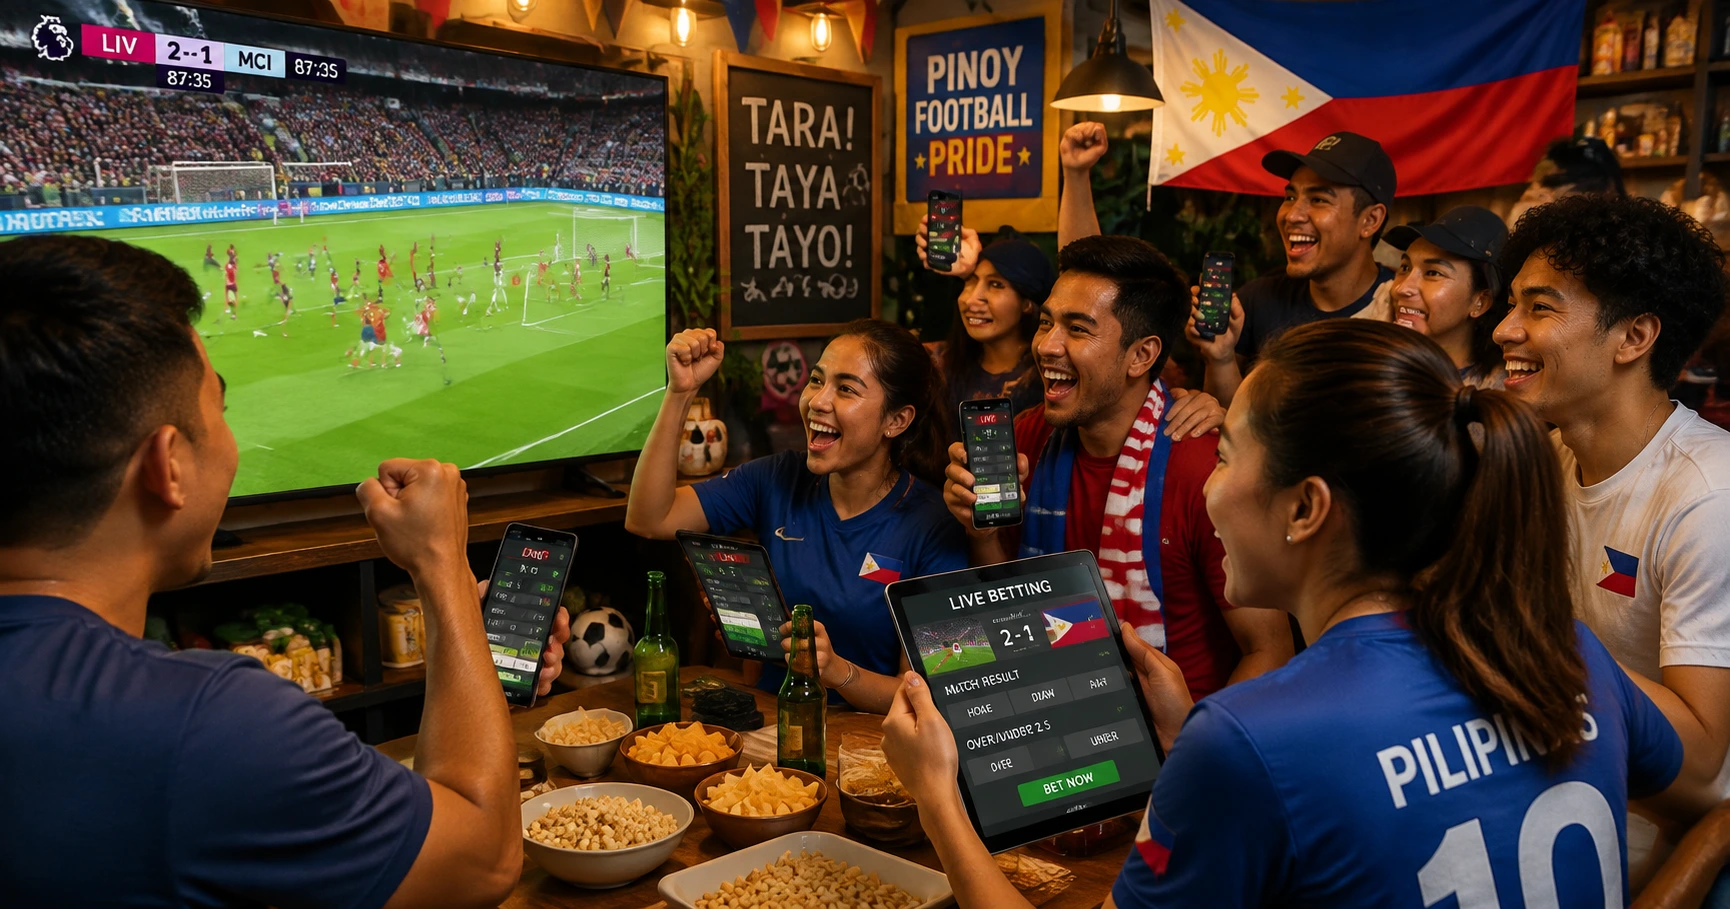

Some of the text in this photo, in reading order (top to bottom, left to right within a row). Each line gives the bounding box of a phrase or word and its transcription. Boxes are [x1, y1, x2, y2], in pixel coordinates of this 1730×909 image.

[102, 33, 137, 55] LIV
[238, 50, 272, 71] MCI
[294, 58, 338, 79] 87:35
[927, 45, 1024, 94] PINOY
[166, 70, 212, 89] 87:35
[741, 96, 855, 151] TARA!
[915, 92, 1033, 134] FOOTBALL
[929, 134, 1014, 177] PRIDE
[745, 162, 842, 210] TAYA
[744, 224, 853, 269] TAYO!
[949, 580, 1052, 610] LIVE BETTING
[981, 670, 1020, 687] RESULT
[1043, 772, 1094, 795] BET NOW
[1417, 780, 1625, 909] 10
